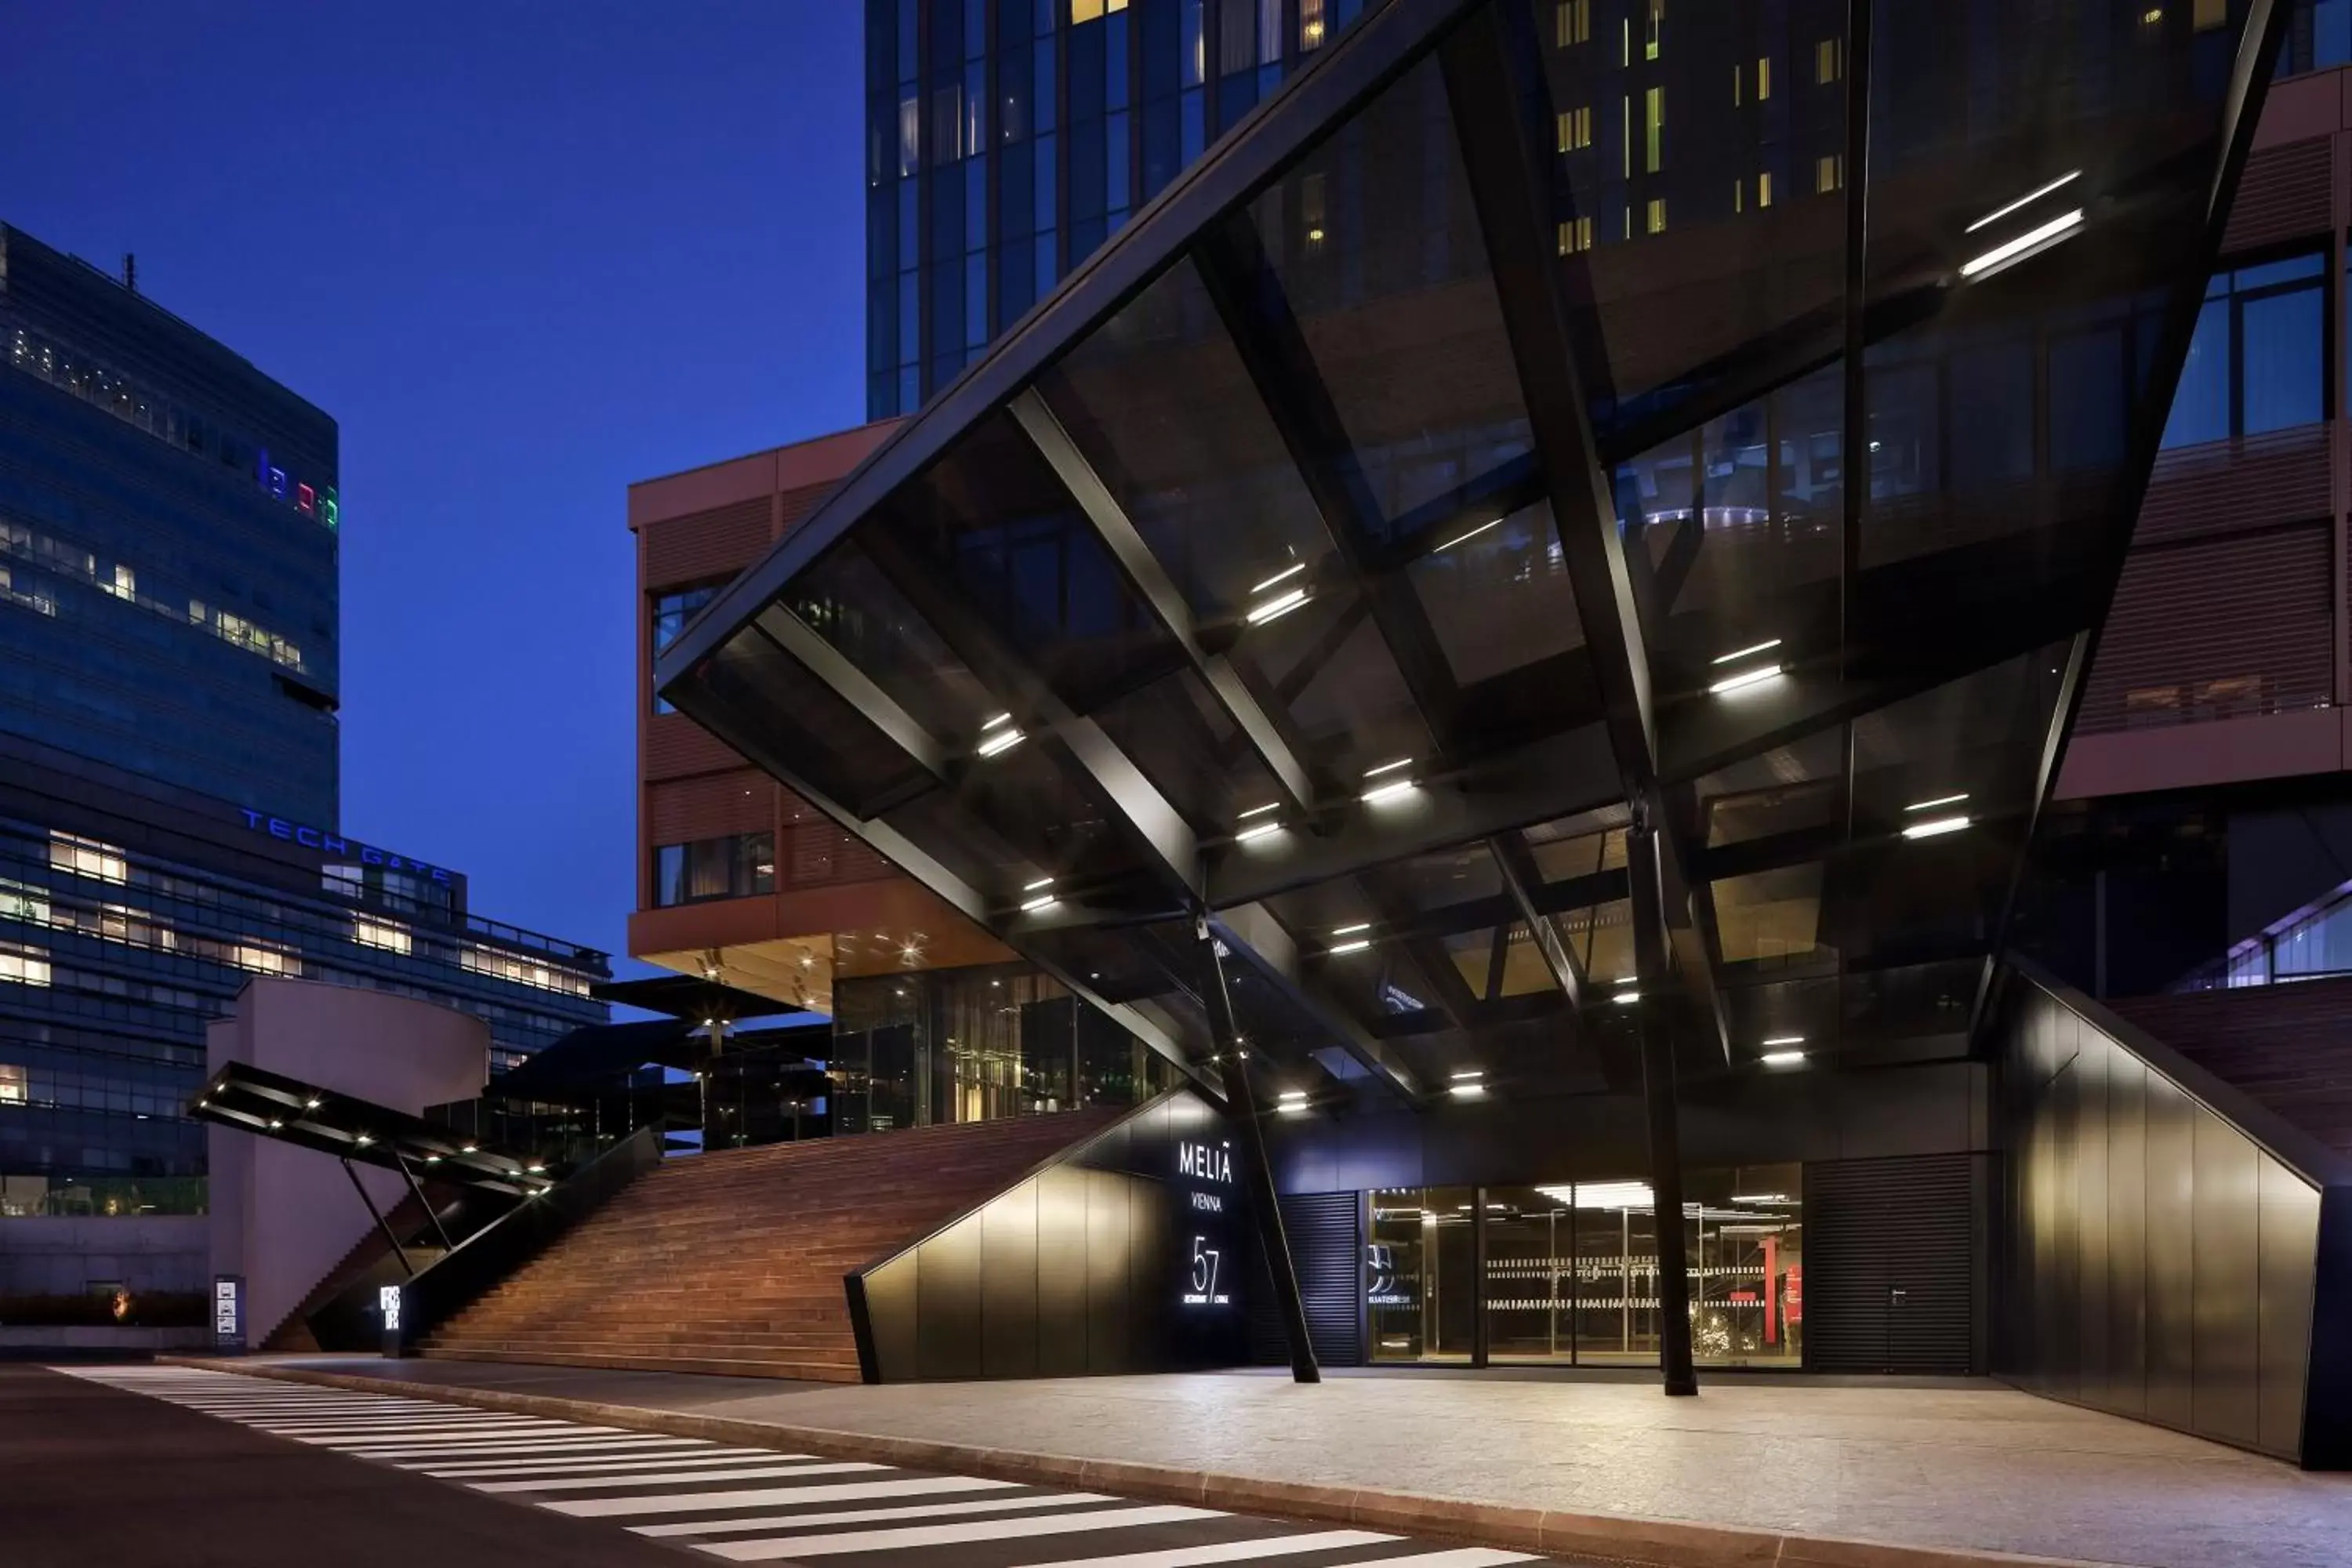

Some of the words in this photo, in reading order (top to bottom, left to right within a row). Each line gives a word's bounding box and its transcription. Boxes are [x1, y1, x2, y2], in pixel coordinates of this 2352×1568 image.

[241, 808, 346, 855] TECH
[1191, 1191, 1223, 1213] VIENNA
[1192, 1236, 1219, 1303] 57
